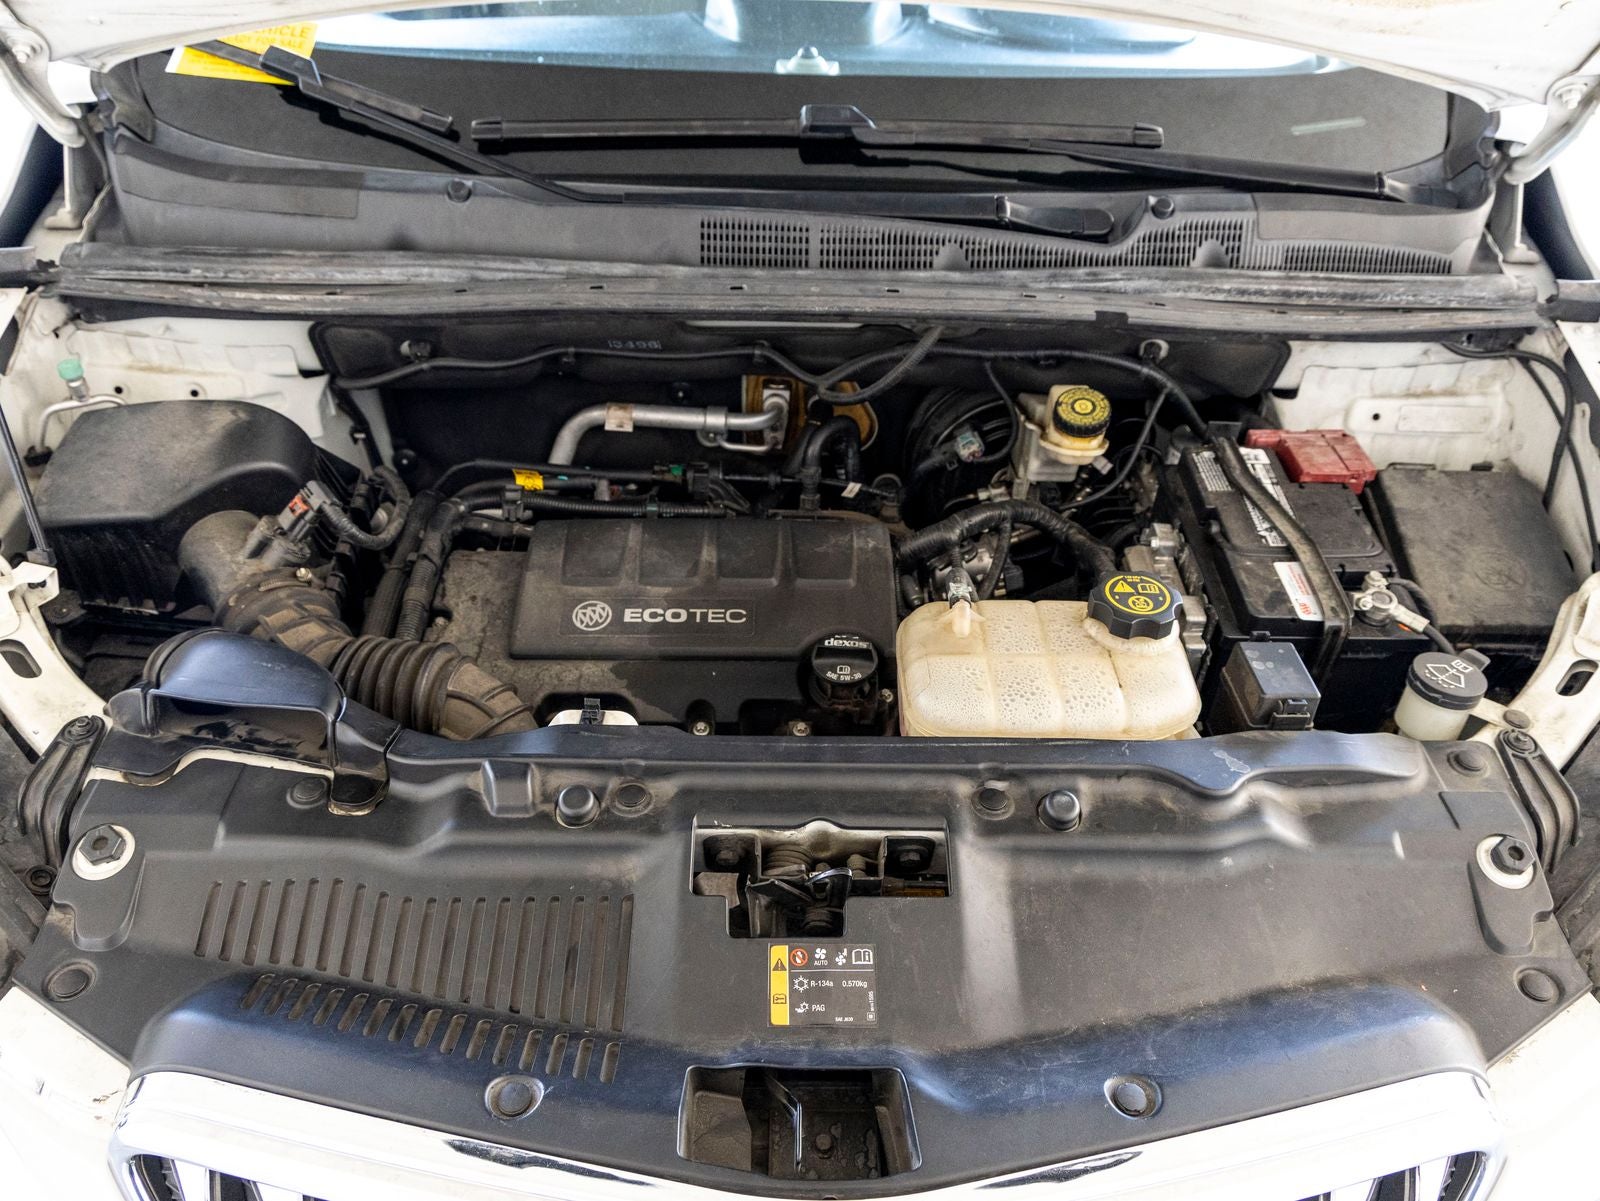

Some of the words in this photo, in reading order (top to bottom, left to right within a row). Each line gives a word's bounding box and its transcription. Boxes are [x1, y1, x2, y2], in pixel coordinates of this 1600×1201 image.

[623, 608, 748, 624] ECOTEC
[824, 637, 870, 649] dexos
[841, 980, 868, 988] 0.570kg
[811, 1004, 826, 1012] PAG
